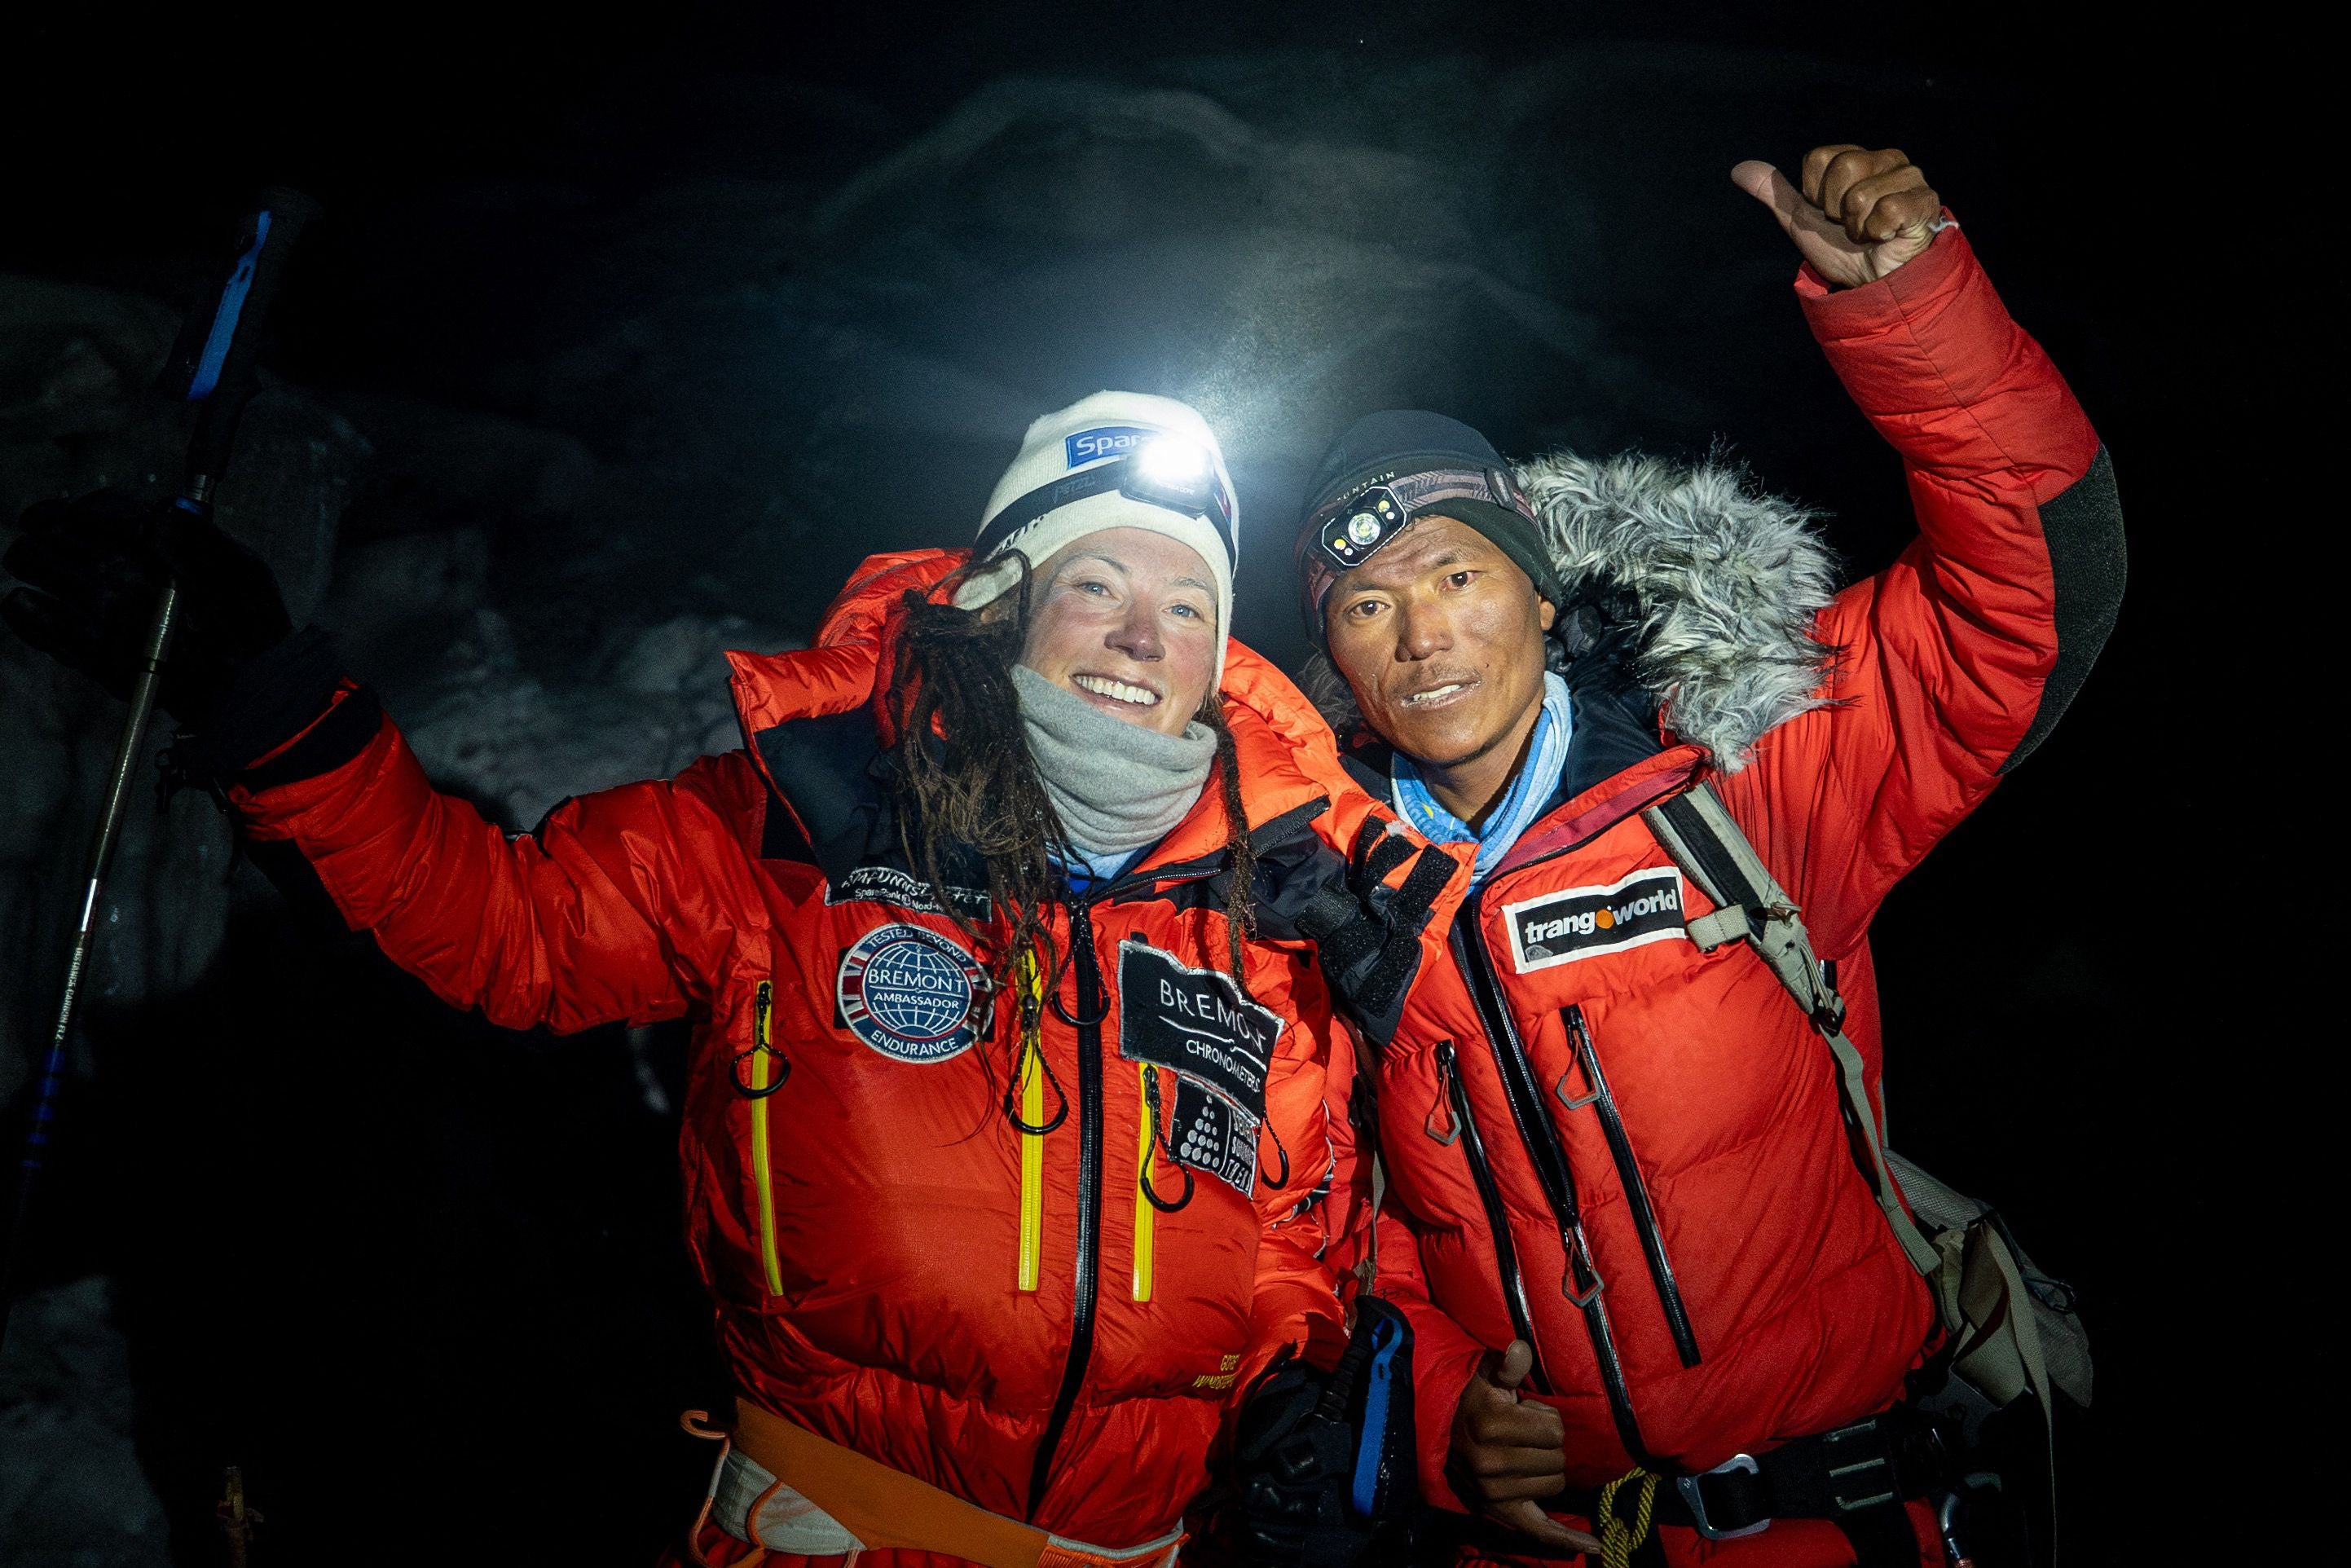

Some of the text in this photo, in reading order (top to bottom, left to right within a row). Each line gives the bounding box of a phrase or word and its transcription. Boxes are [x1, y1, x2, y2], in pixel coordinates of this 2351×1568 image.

[1076, 434, 1141, 456] Spar
[1337, 471, 1395, 501] UNTAIN
[865, 927, 914, 949] TESTED
[868, 968, 965, 993] BREMONT
[874, 992, 960, 1010] AMBASSADOR
[870, 1029, 959, 1056] ENDURANCE
[1186, 1039, 1261, 1093] CHRONOMETERS
